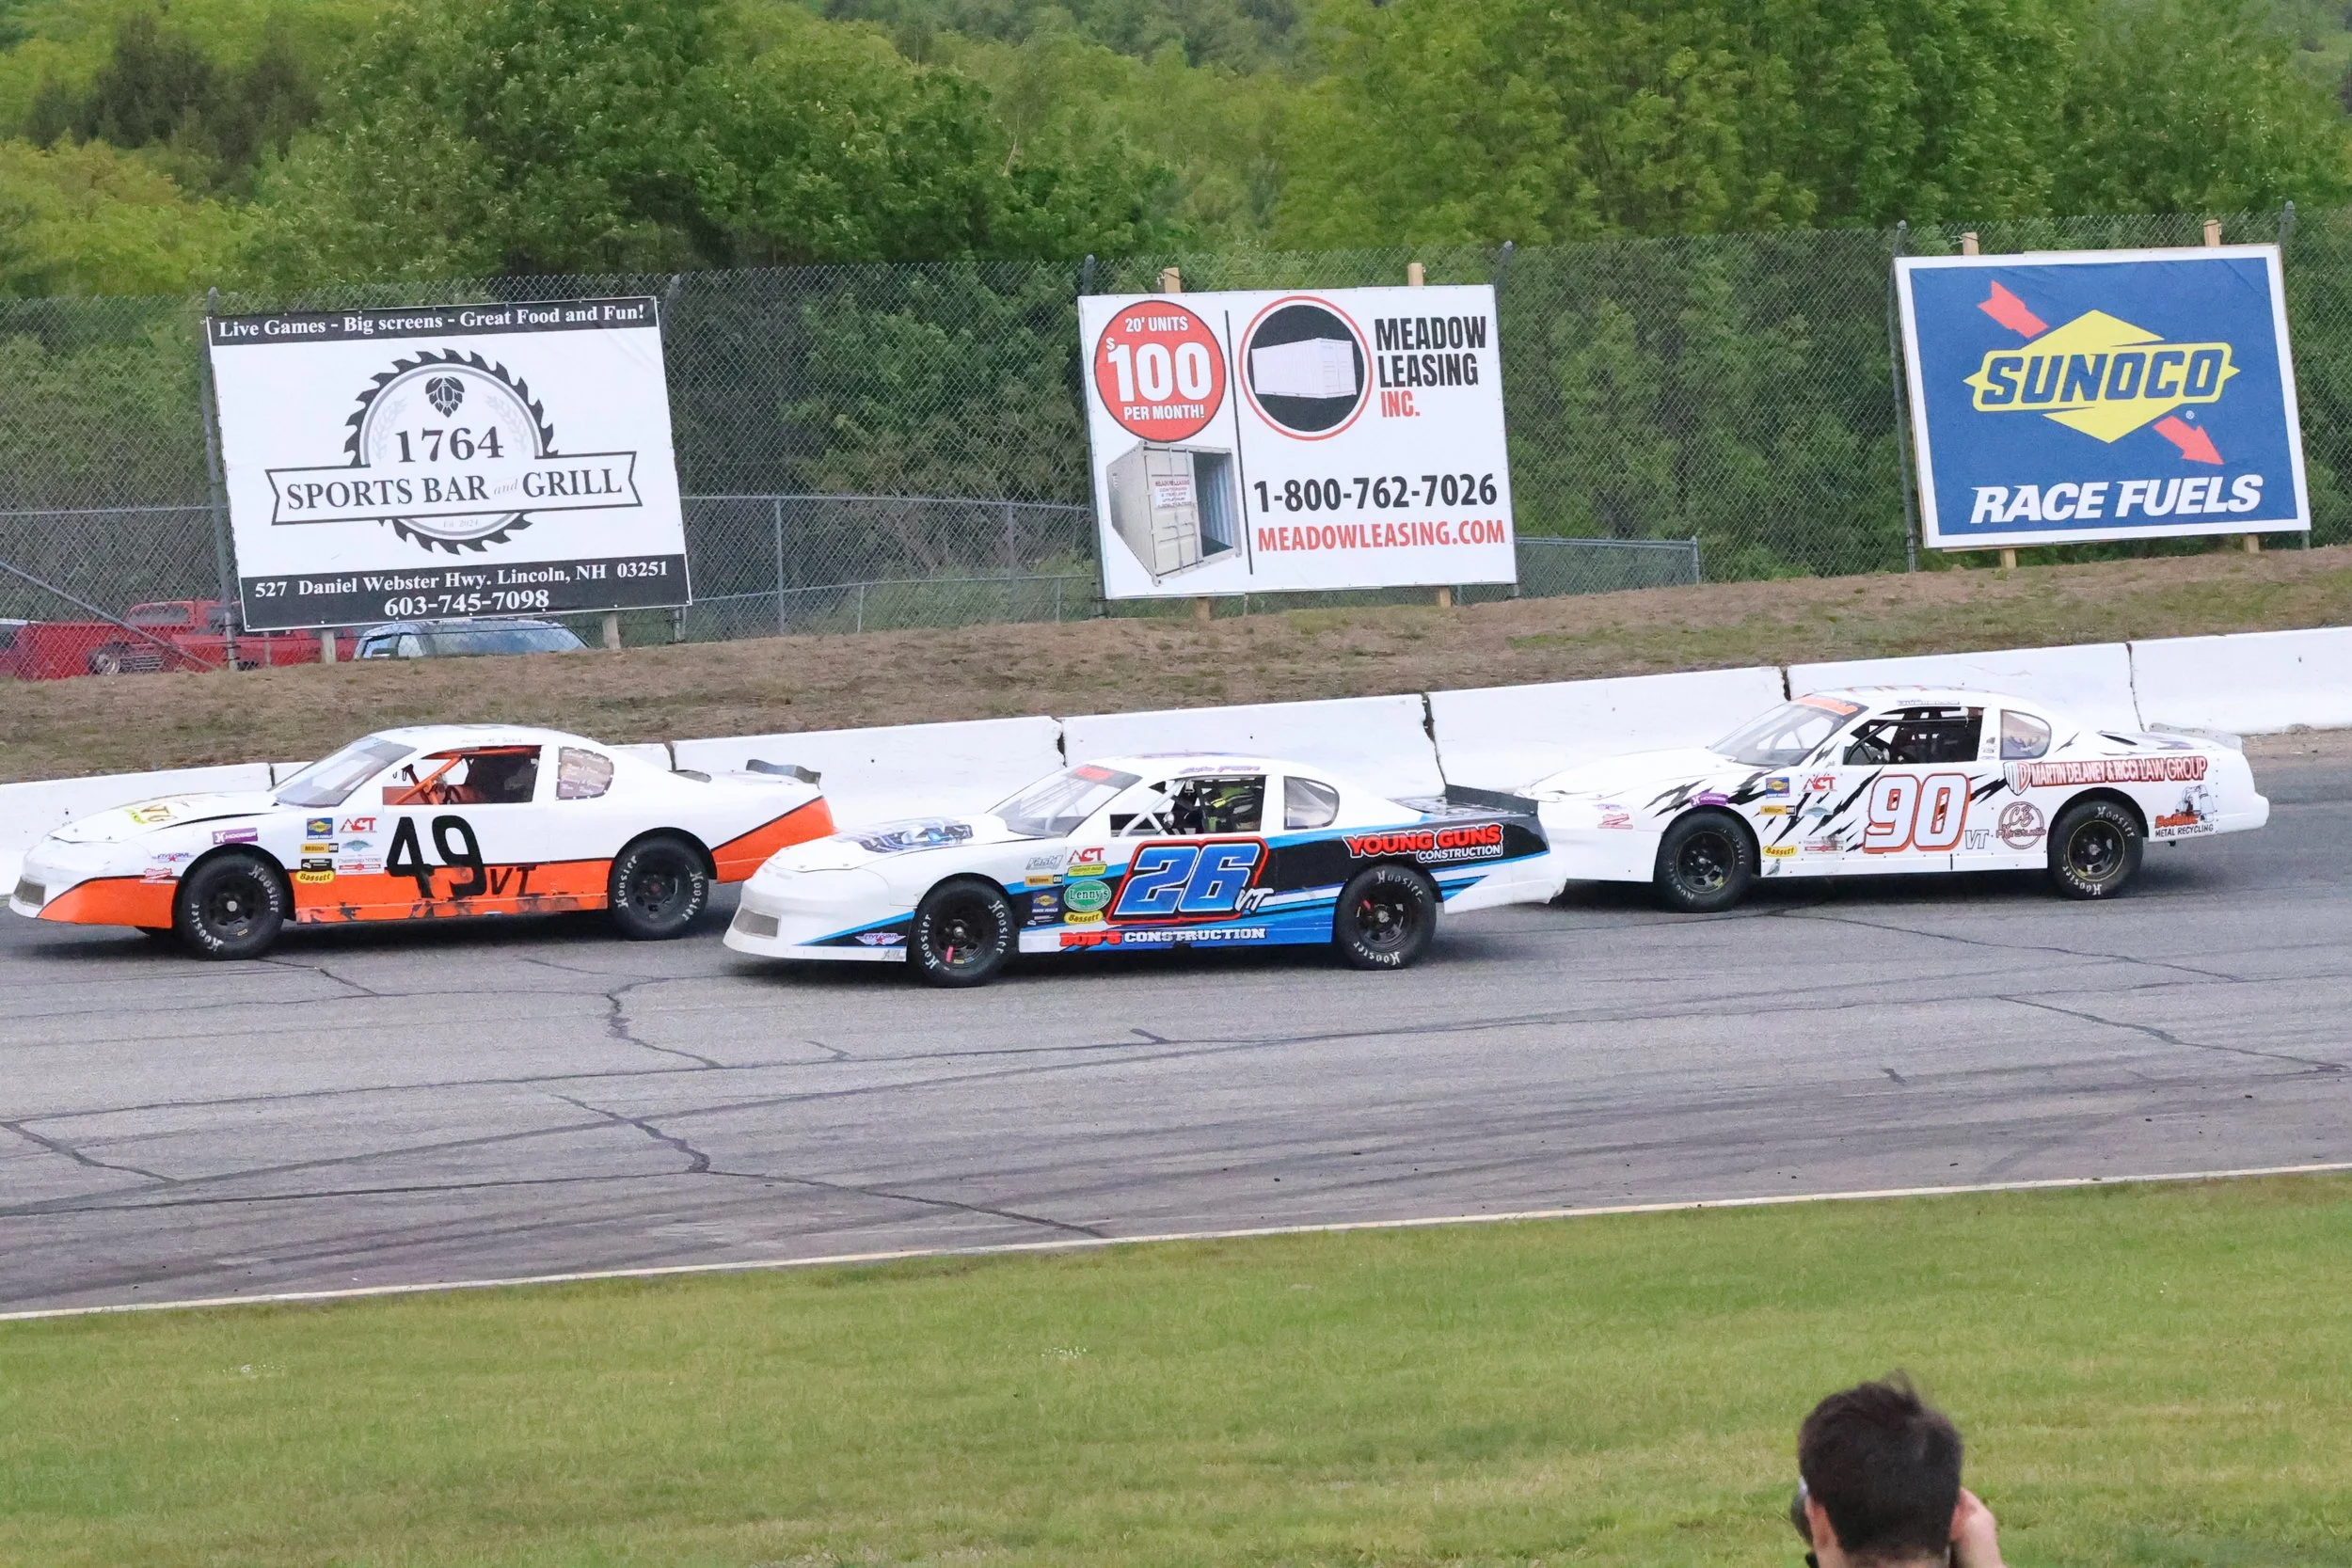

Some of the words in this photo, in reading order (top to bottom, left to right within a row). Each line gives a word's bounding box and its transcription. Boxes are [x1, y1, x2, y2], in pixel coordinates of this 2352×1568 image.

[218, 321, 259, 337] Live
[264, 319, 326, 335] Games
[343, 316, 374, 334] Big
[378, 315, 443, 330] screens
[459, 309, 511, 327] Great
[516, 308, 560, 325] Food
[565, 306, 597, 322] and
[602, 304, 644, 321] Fun!
[1124, 317, 1145, 333] 20'
[1148, 315, 1189, 333] UNITS
[1375, 315, 1486, 351] MEADOW
[1377, 353, 1479, 388] LEASING
[1980, 348, 2224, 404] SUNOCO
[1123, 405, 1150, 421] PER
[1152, 404, 1205, 420] MONTH!
[1381, 389, 1421, 418] INC.
[395, 426, 504, 464] 1764
[286, 478, 413, 510] SPORTS
[423, 474, 490, 503] BAR
[493, 478, 519, 496] and
[522, 467, 623, 498] GRILL
[1253, 473, 1498, 513] 1-800-762-7026
[1969, 482, 2109, 524] RACE
[2115, 474, 2264, 517] FUELS
[1258, 519, 1505, 552] MEADOWLEASING.COM
[255, 581, 288, 598] 527
[297, 578, 358, 595] Daniel
[362, 575, 439, 593] Webster
[444, 572, 492, 590] Hwy.
[497, 567, 571, 584] Lincoln,
[575, 564, 607, 580] NH
[616, 561, 668, 578] 03251
[384, 589, 549, 617] 603-745-7098
[2032, 764, 2067, 785] MARTIN
[2068, 761, 2106, 784] DELANEY
[2106, 761, 2114, 781] &
[2114, 759, 2139, 781] RICCI
[2139, 757, 2165, 782] LAW
[2166, 756, 2207, 781] GROUP
[1863, 772, 1971, 854] 90
[1964, 829, 1990, 850] VT
[1345, 832, 1435, 855] YOUNG
[1437, 824, 1502, 848] GUNS
[2155, 828, 2176, 838] METAL
[2177, 824, 2214, 836] RECYCLING
[387, 815, 487, 901] 49
[490, 864, 538, 897] VT
[1418, 846, 1502, 861] CONSTRUCTION
[1766, 847, 1794, 855] Bassett
[248, 864, 279, 913] Hoosier
[299, 873, 331, 882] Bassett
[1114, 843, 1261, 916] 26
[1234, 887, 1274, 912] VT
[1376, 870, 1423, 899] Hoosier
[1069, 888, 1109, 902] Lenny's
[988, 900, 1009, 955] Hoosier
[1068, 913, 1100, 922] Bassett
[920, 913, 941, 970] Hoosier
[1124, 927, 1266, 943] CONSTRUCTION
